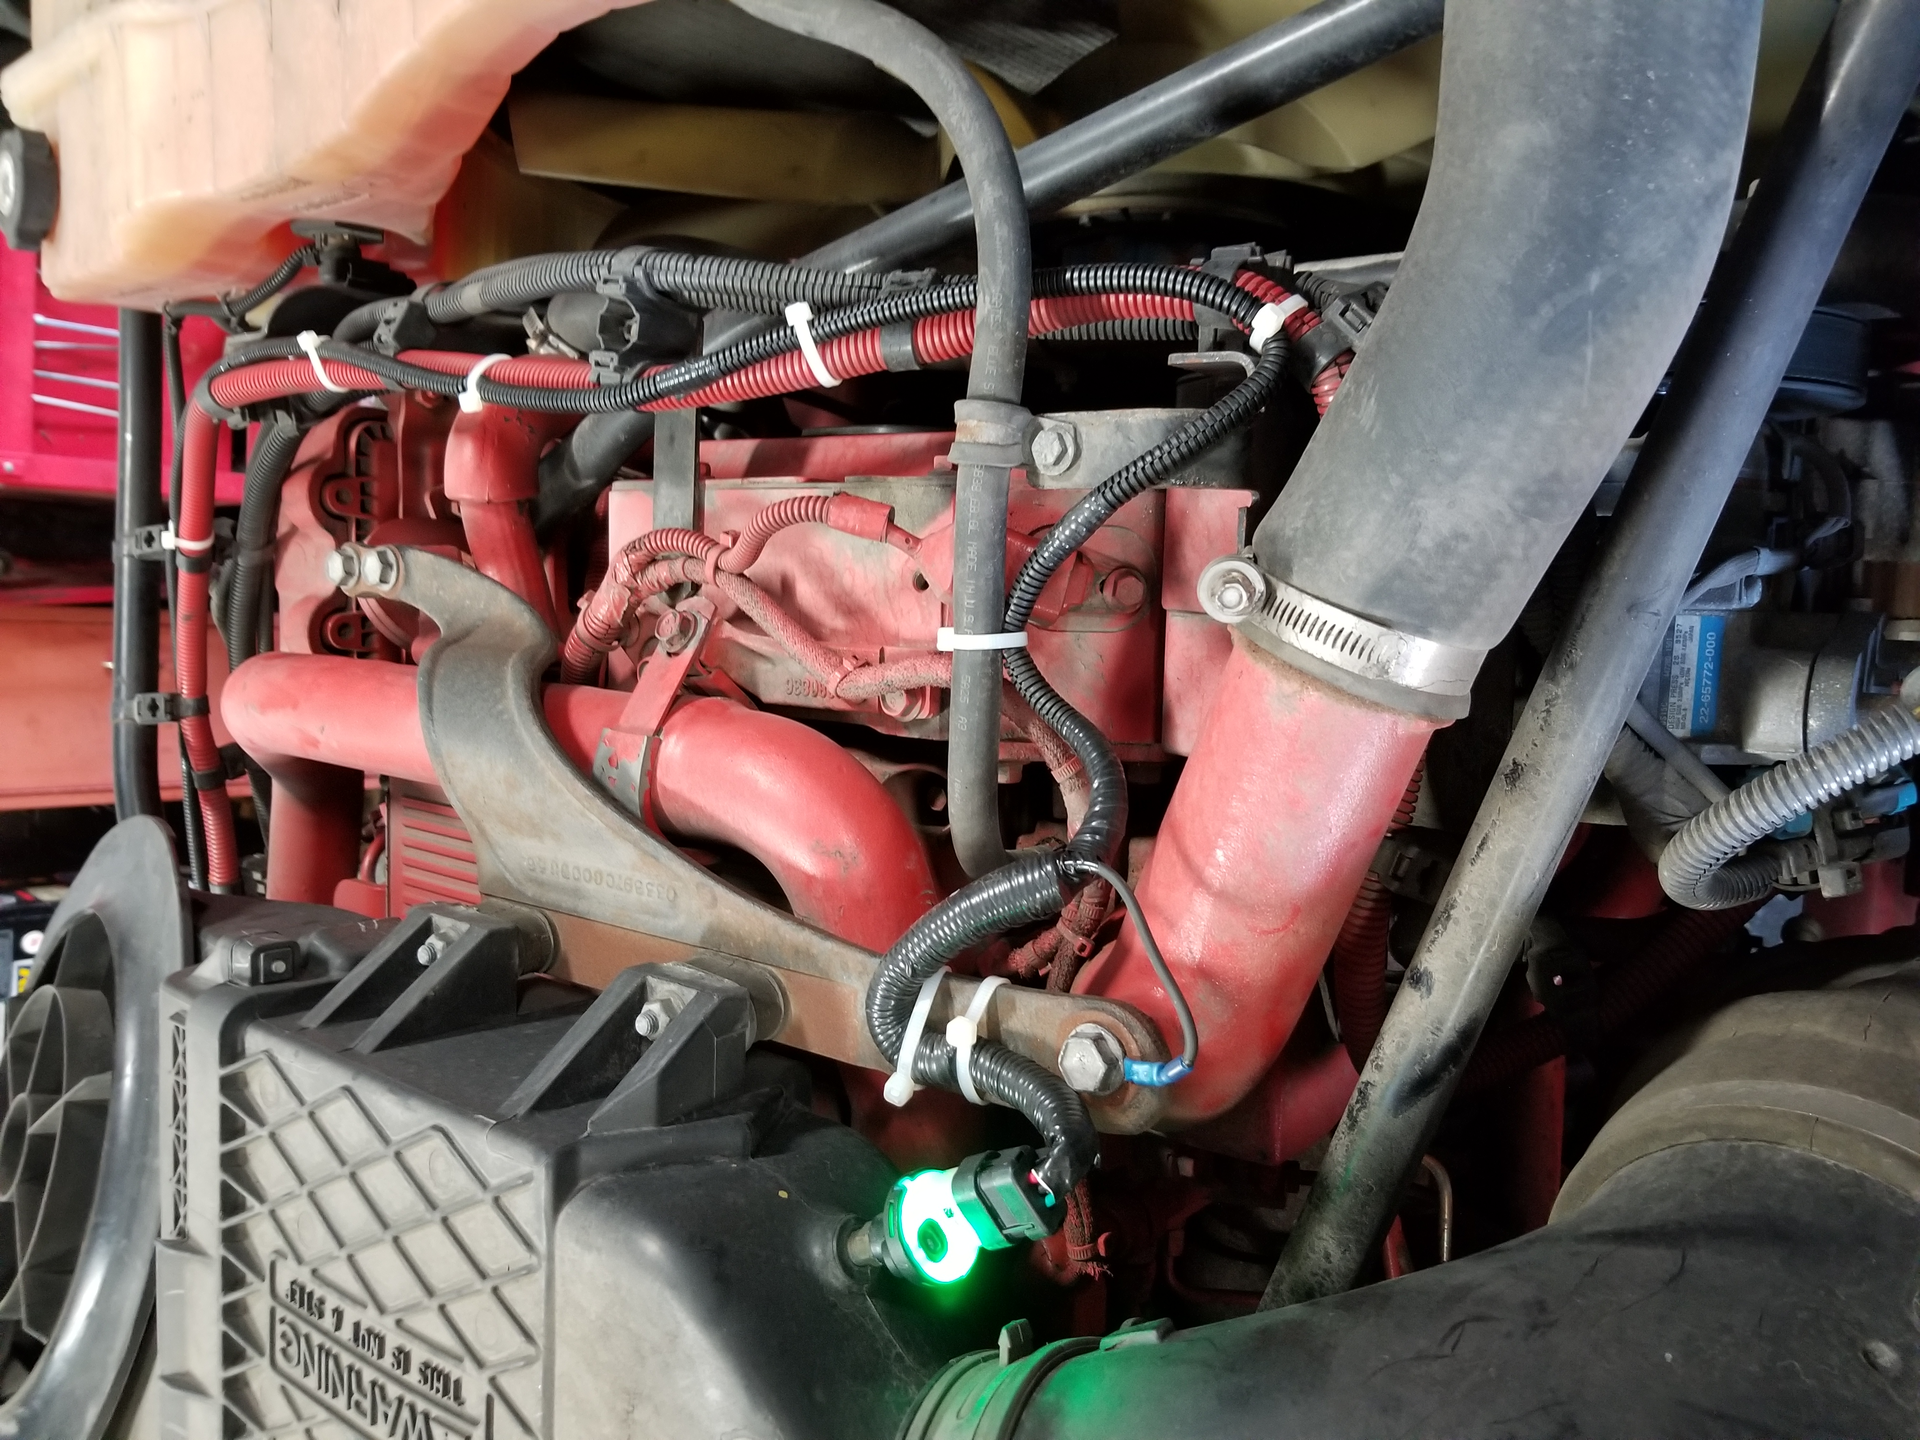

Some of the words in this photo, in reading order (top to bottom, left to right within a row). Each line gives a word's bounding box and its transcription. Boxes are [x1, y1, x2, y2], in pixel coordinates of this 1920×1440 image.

[985, 345, 998, 377] BLUE
[966, 541, 978, 572] MADE
[1669, 674, 1679, 699] PRESS
[1699, 631, 1717, 724] 22-65772-000
[1667, 702, 1676, 730] DESIGN
[284, 1278, 327, 1322] STEP
[331, 1306, 345, 1334] A
[348, 1320, 386, 1361] NOT
[390, 1345, 412, 1377] IS
[279, 1317, 436, 1440] WARNING
[418, 1360, 466, 1408] THIS
